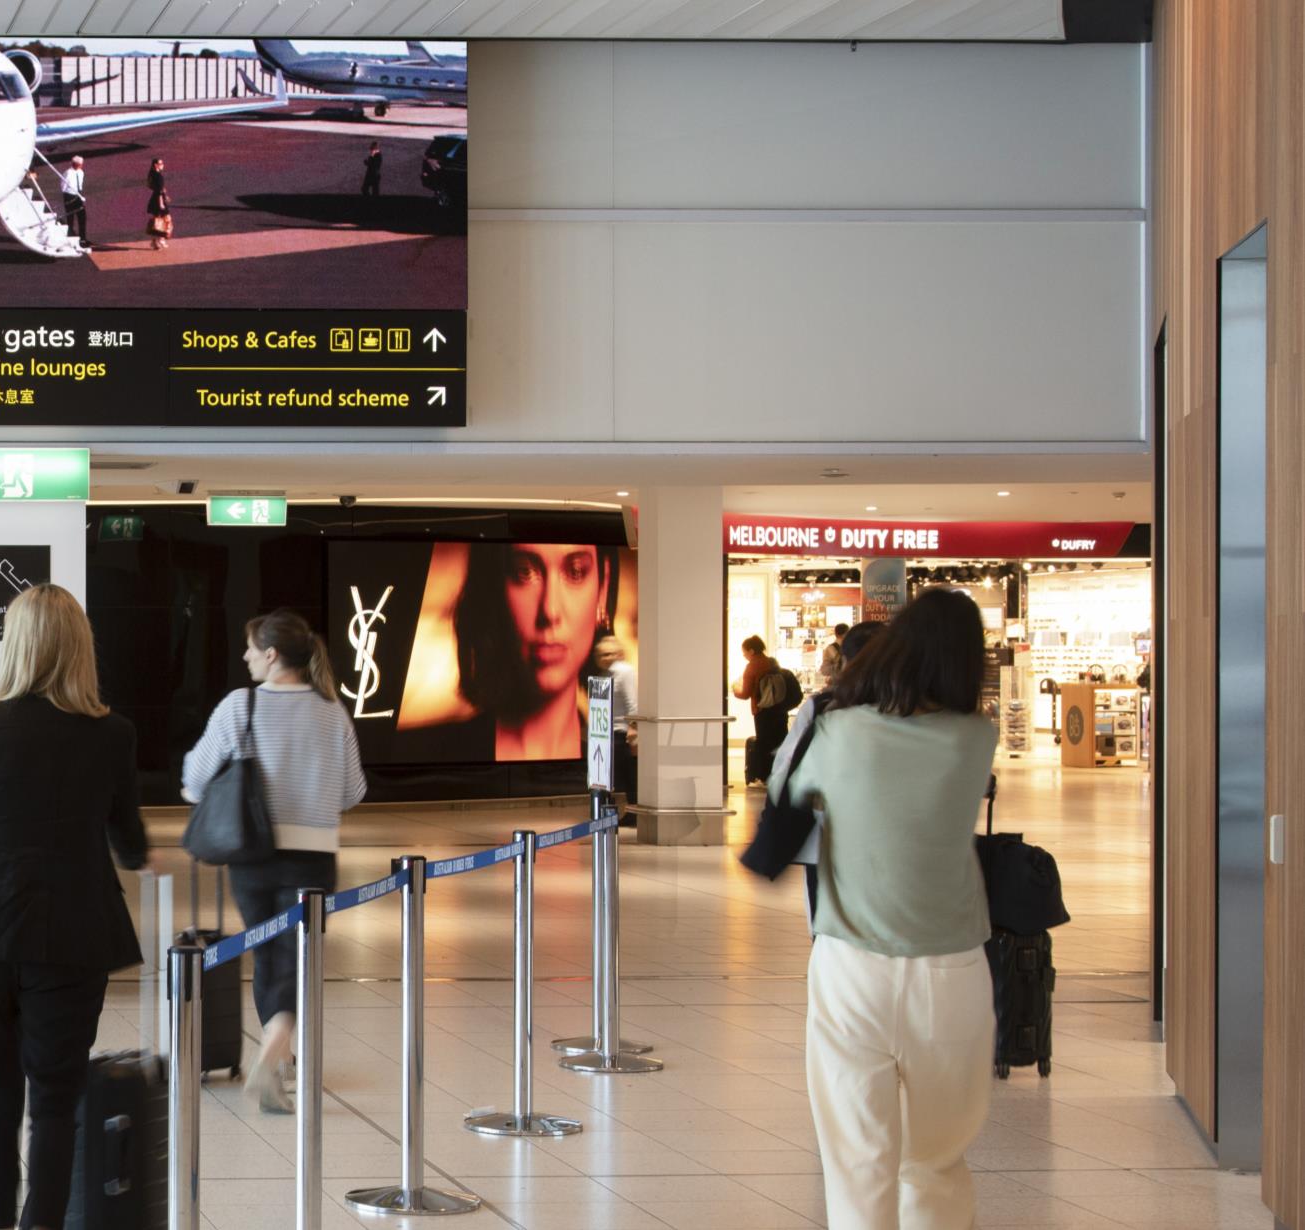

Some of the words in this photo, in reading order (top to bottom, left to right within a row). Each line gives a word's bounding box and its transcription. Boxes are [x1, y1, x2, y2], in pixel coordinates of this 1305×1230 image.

[4, 326, 75, 352] gates
[88, 331, 133, 347] 登机口
[182, 331, 239, 352] Shops
[245, 332, 258, 348] &
[265, 330, 317, 348] Cafes
[31, 358, 106, 380] lounges
[196, 389, 262, 406] Tourist
[268, 389, 332, 406] refund
[338, 389, 409, 407] scheme
[729, 526, 819, 547] MELBOURNE
[841, 529, 888, 548] DUTY
[893, 529, 939, 549] FREE
[1061, 540, 1096, 550] DUFRY
[340, 585, 394, 718] YSL
[591, 706, 609, 733] TRS
